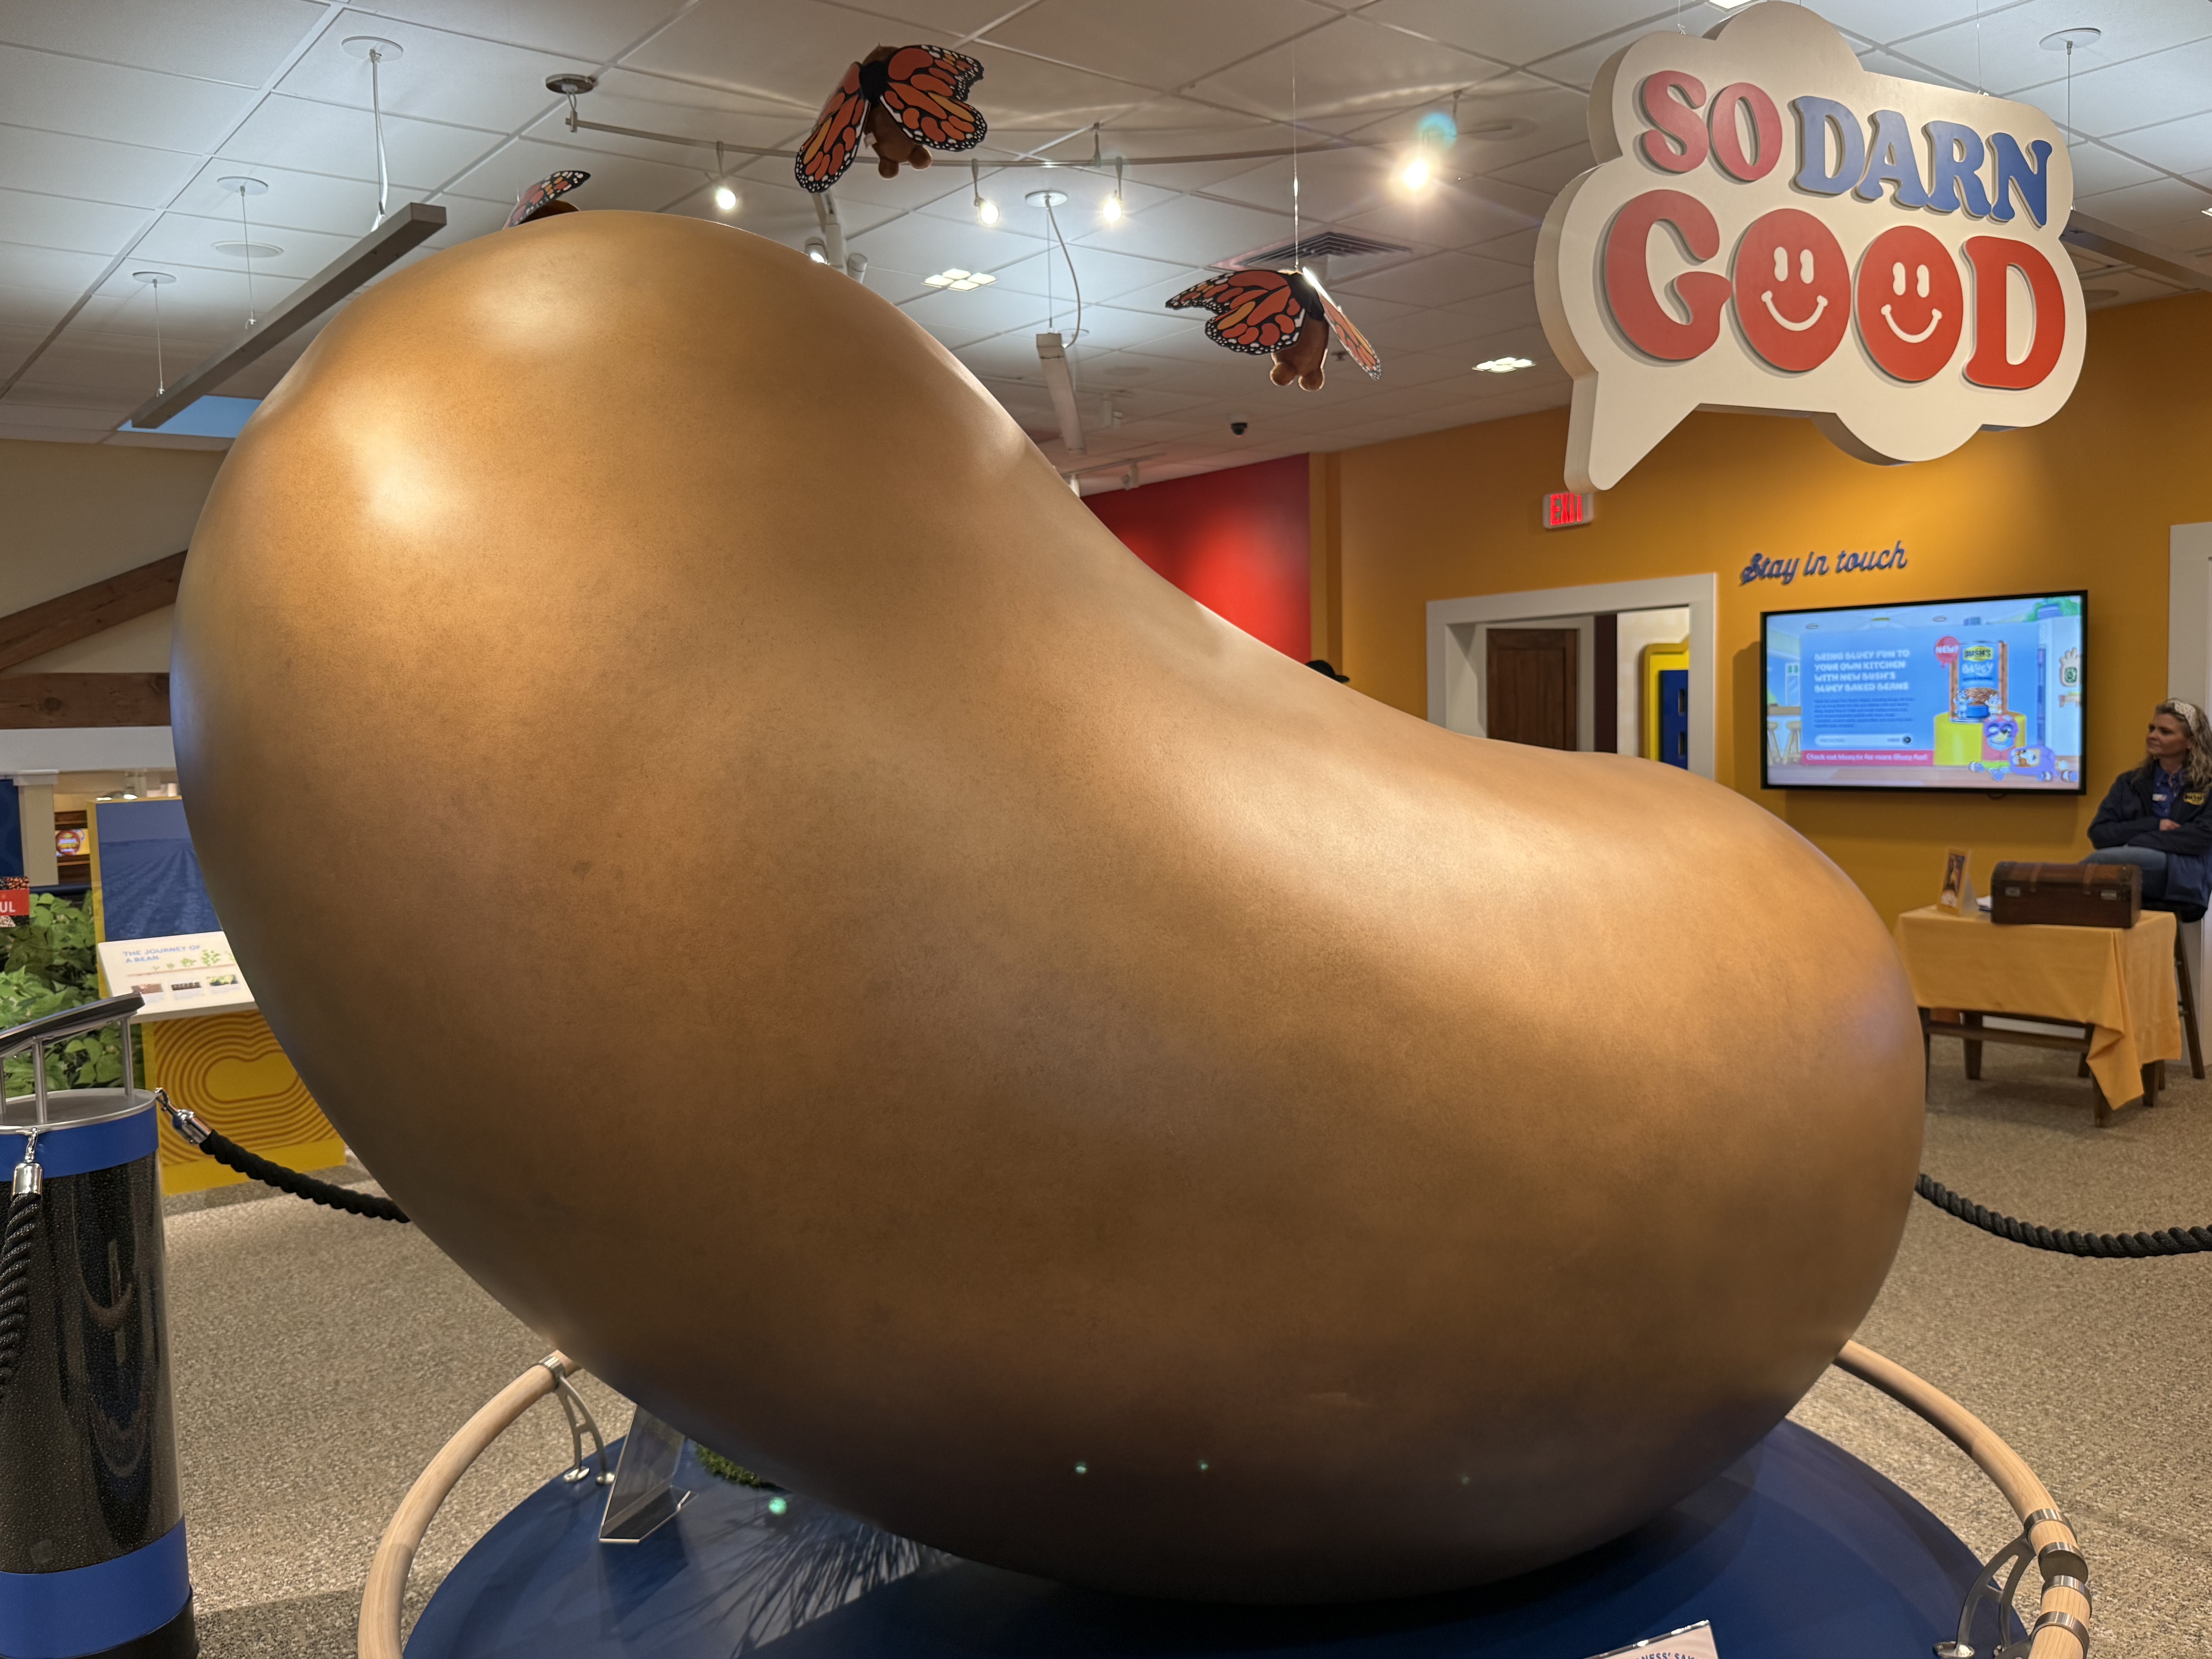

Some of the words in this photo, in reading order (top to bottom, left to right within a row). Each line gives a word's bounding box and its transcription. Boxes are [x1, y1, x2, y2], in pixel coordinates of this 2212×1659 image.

[1640, 70, 1782, 182] SO
[1791, 95, 2052, 228] DARN
[1604, 189, 2066, 389] GOOD
[1741, 553, 1800, 585] Stay
[1803, 551, 1829, 576] in
[1836, 541, 1908, 573] touch
[1844, 651, 1874, 660] BLUEY
[1876, 650, 1895, 658] FUN
[1897, 649, 1910, 658] TO
[1964, 649, 1992, 658] BUSH'S
[1814, 663, 1838, 672] YOUR
[1840, 662, 1862, 671] OWN
[1863, 660, 1906, 670] KITCHEN
[1814, 674, 1838, 682] WITH
[1840, 673, 1860, 682] NEW
[1814, 684, 1843, 692] BLUEY
[1844, 682, 1875, 692] BAKED
[1877, 682, 1908, 691] BEANS
[145, 946, 186, 955] JOURNEY
